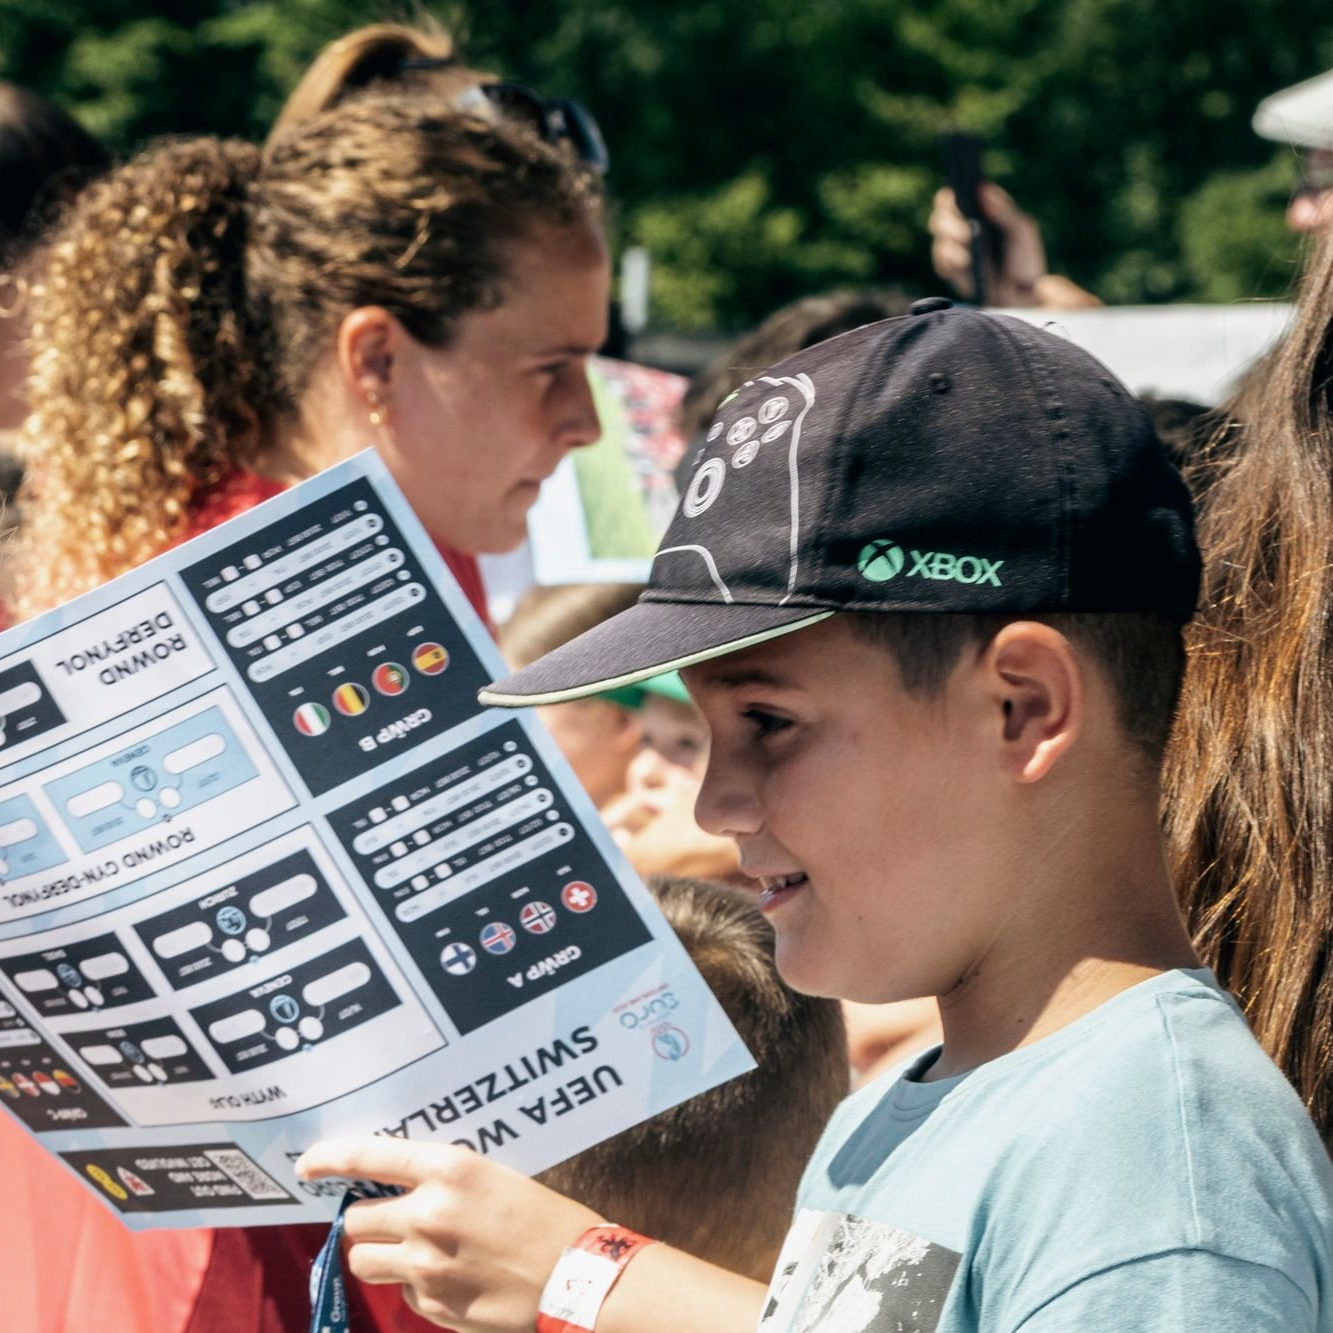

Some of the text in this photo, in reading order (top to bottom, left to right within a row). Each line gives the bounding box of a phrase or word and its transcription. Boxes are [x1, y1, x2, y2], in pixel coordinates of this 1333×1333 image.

[906, 550, 1005, 587] XBOX
[53, 610, 174, 679] DERFYNOL
[96, 632, 188, 687] ROWND
[356, 733, 377, 754] B
[119, 825, 196, 870] ROWND
[505, 968, 529, 991] A
[378, 1023, 601, 1138] SWITZERLA
[517, 1061, 623, 1130] UEFA
